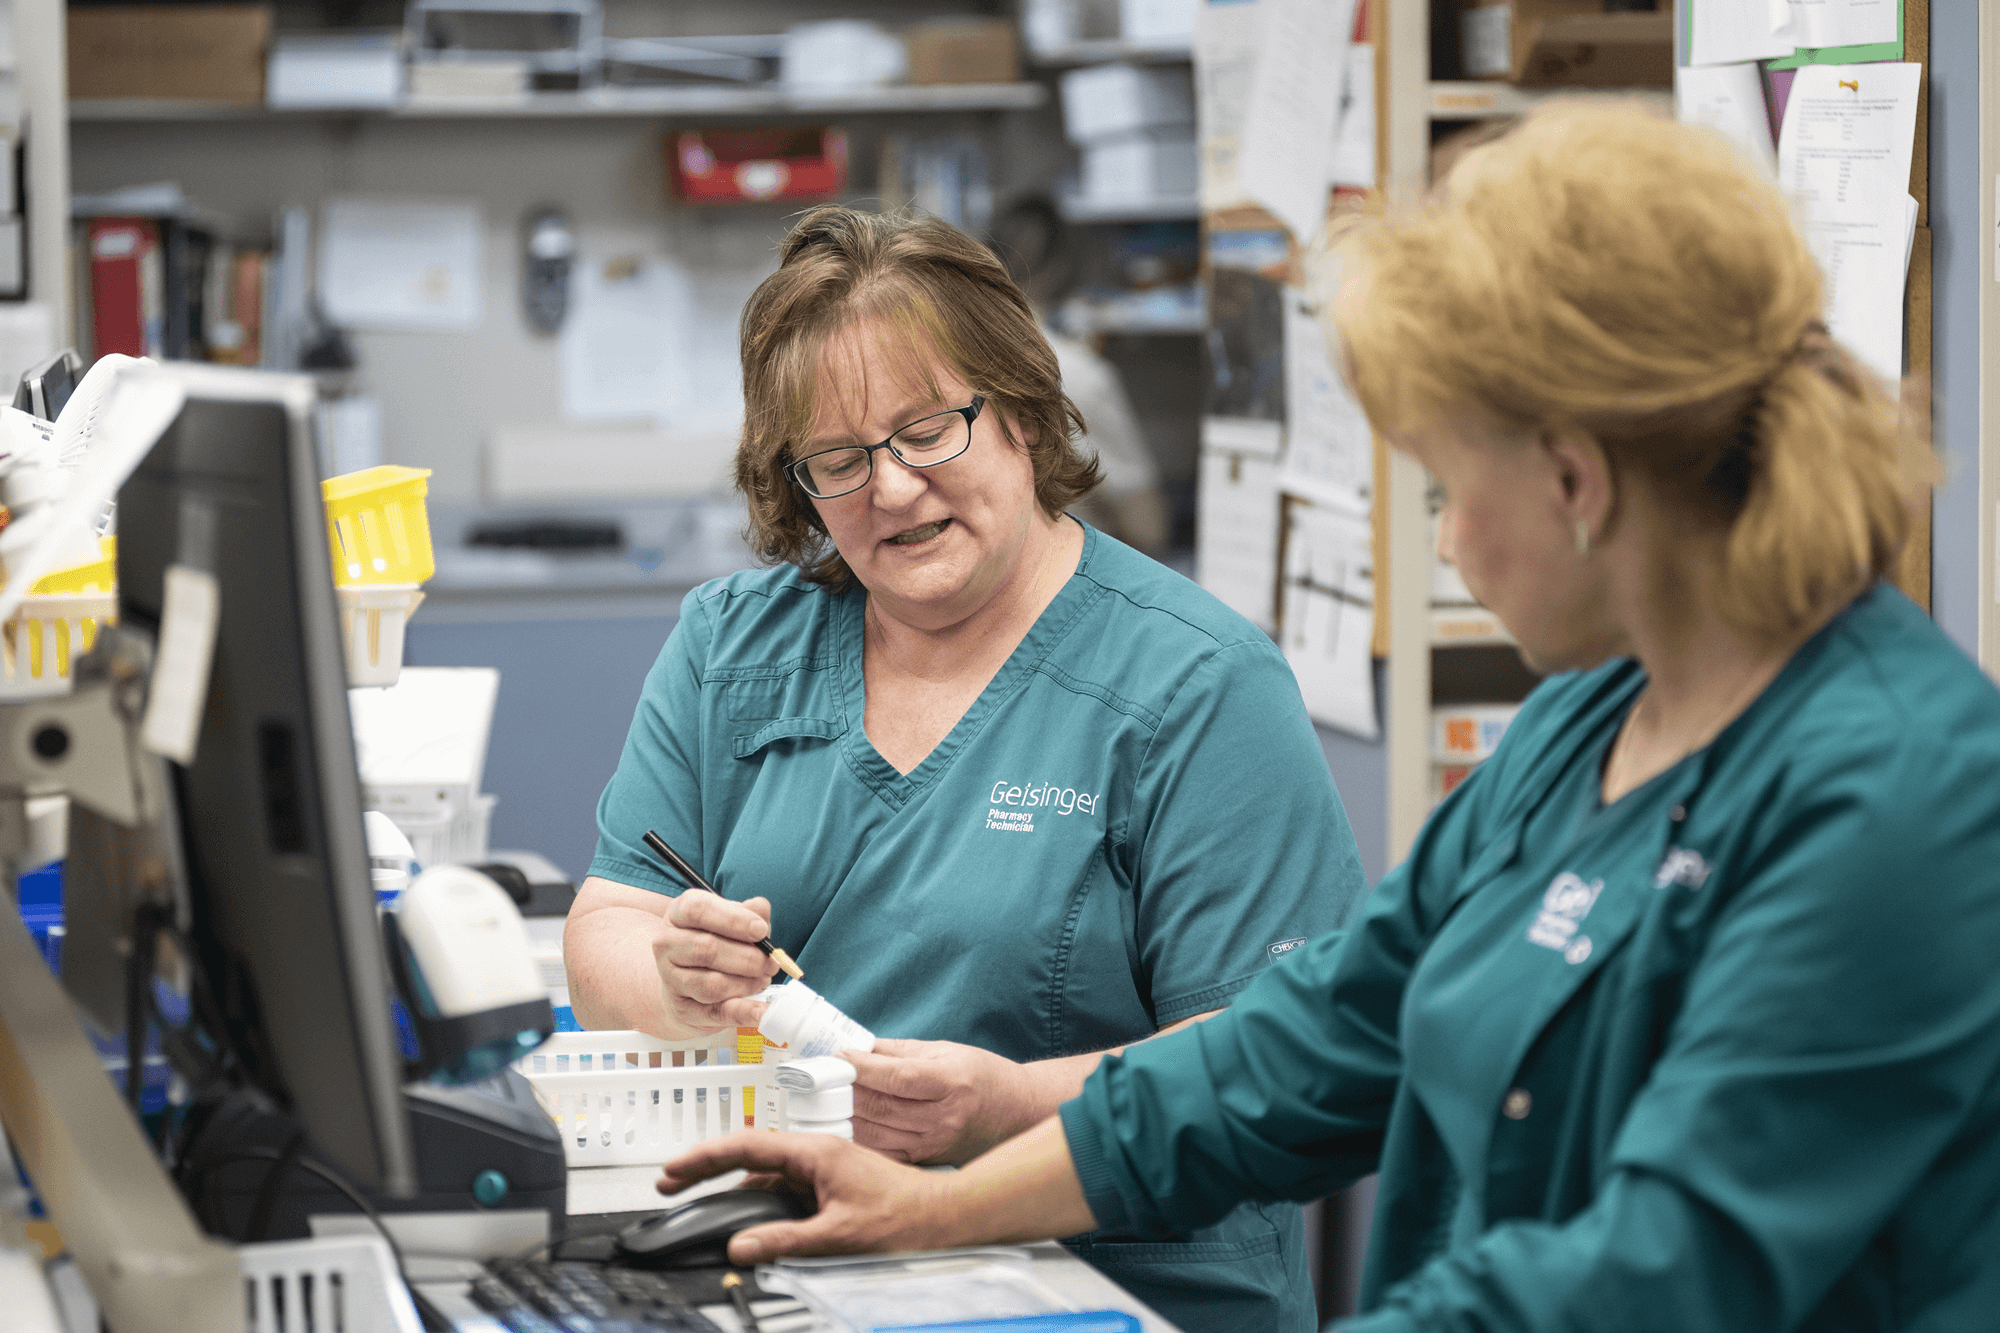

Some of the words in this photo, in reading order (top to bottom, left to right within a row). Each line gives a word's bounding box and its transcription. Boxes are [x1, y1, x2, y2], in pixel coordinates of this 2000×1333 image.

[990, 780, 1100, 816] Geisinger
[988, 808, 1033, 823] Pharmacy
[985, 819, 1034, 832] Technician
